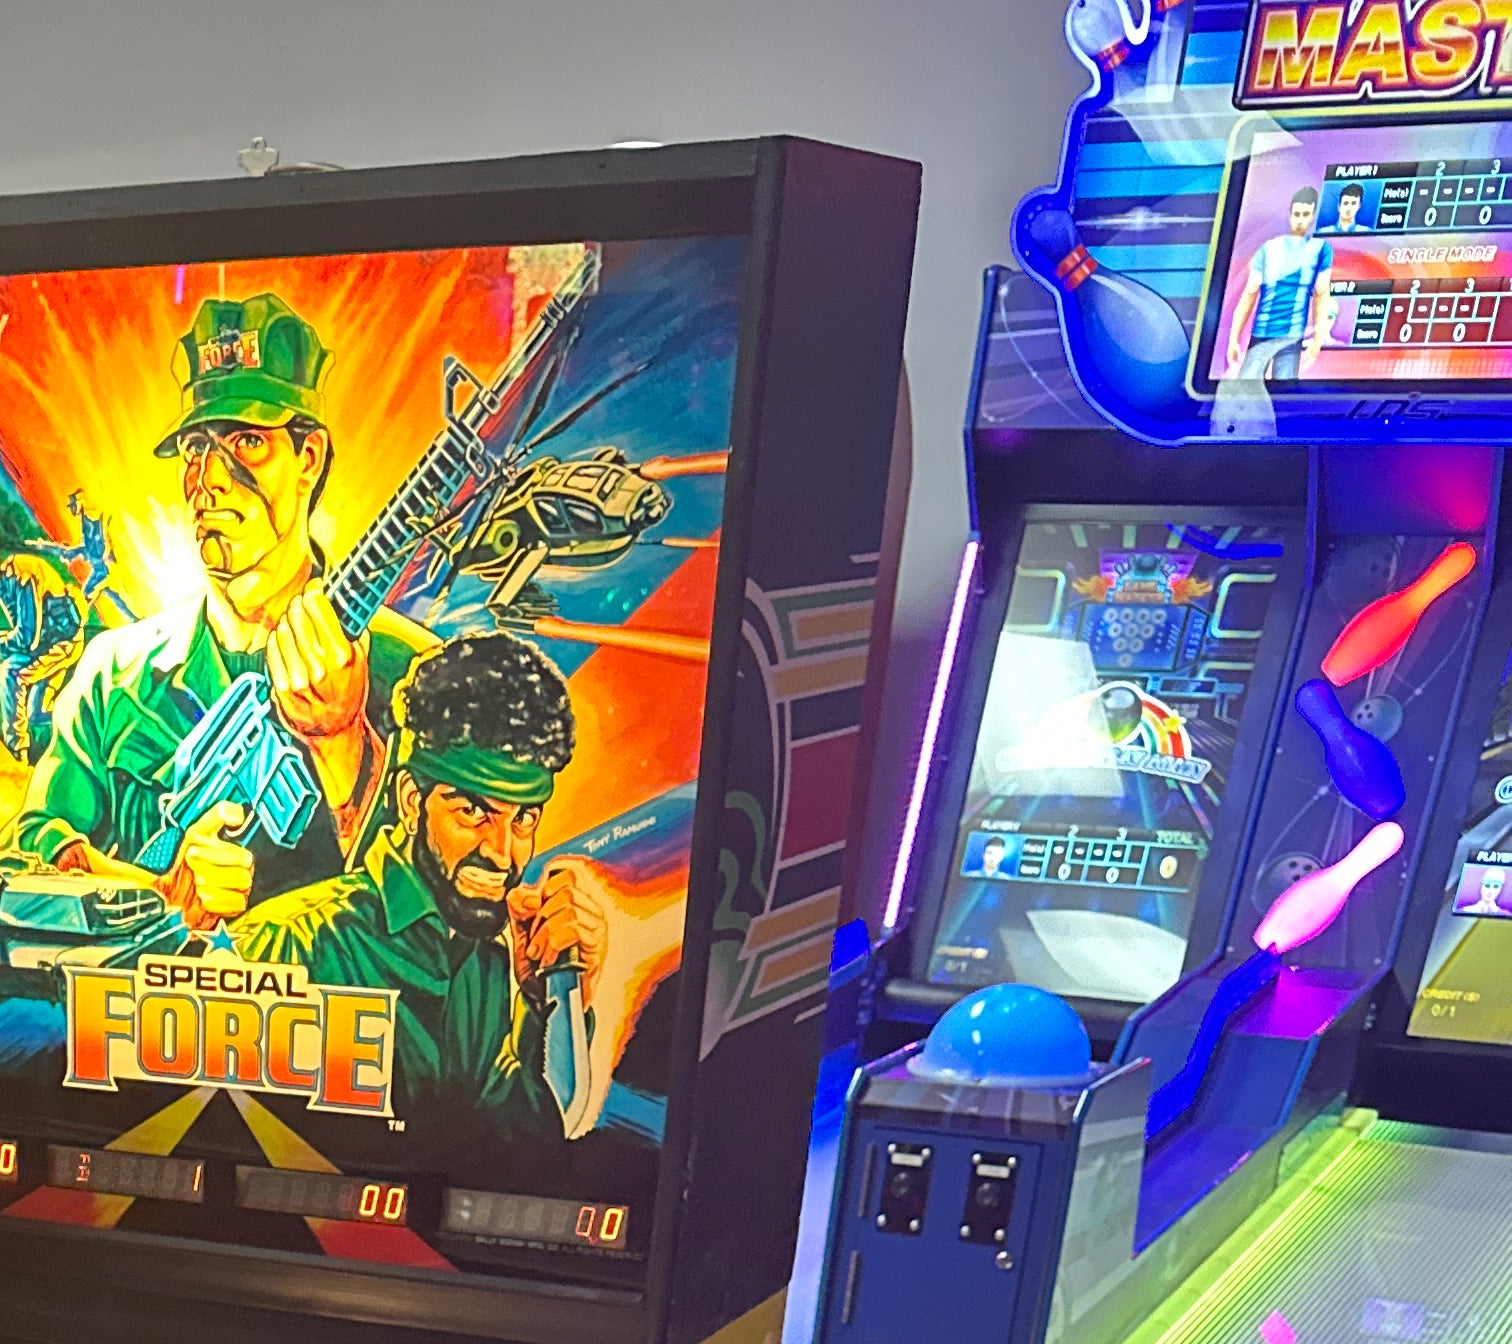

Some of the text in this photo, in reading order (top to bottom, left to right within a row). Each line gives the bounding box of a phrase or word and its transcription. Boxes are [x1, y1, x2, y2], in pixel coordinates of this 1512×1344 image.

[1424, 207, 1437, 227] 0
[1479, 205, 1492, 225] 0
[1389, 246, 1497, 263] SINGLE MODE
[1400, 323, 1412, 343] 0
[1453, 323, 1466, 342] 0
[1157, 831, 1194, 844] TOTAL
[145, 963, 307, 998] SPECIAL
[70, 968, 393, 1113] FORCE
[359, 1179, 406, 1220] 00
